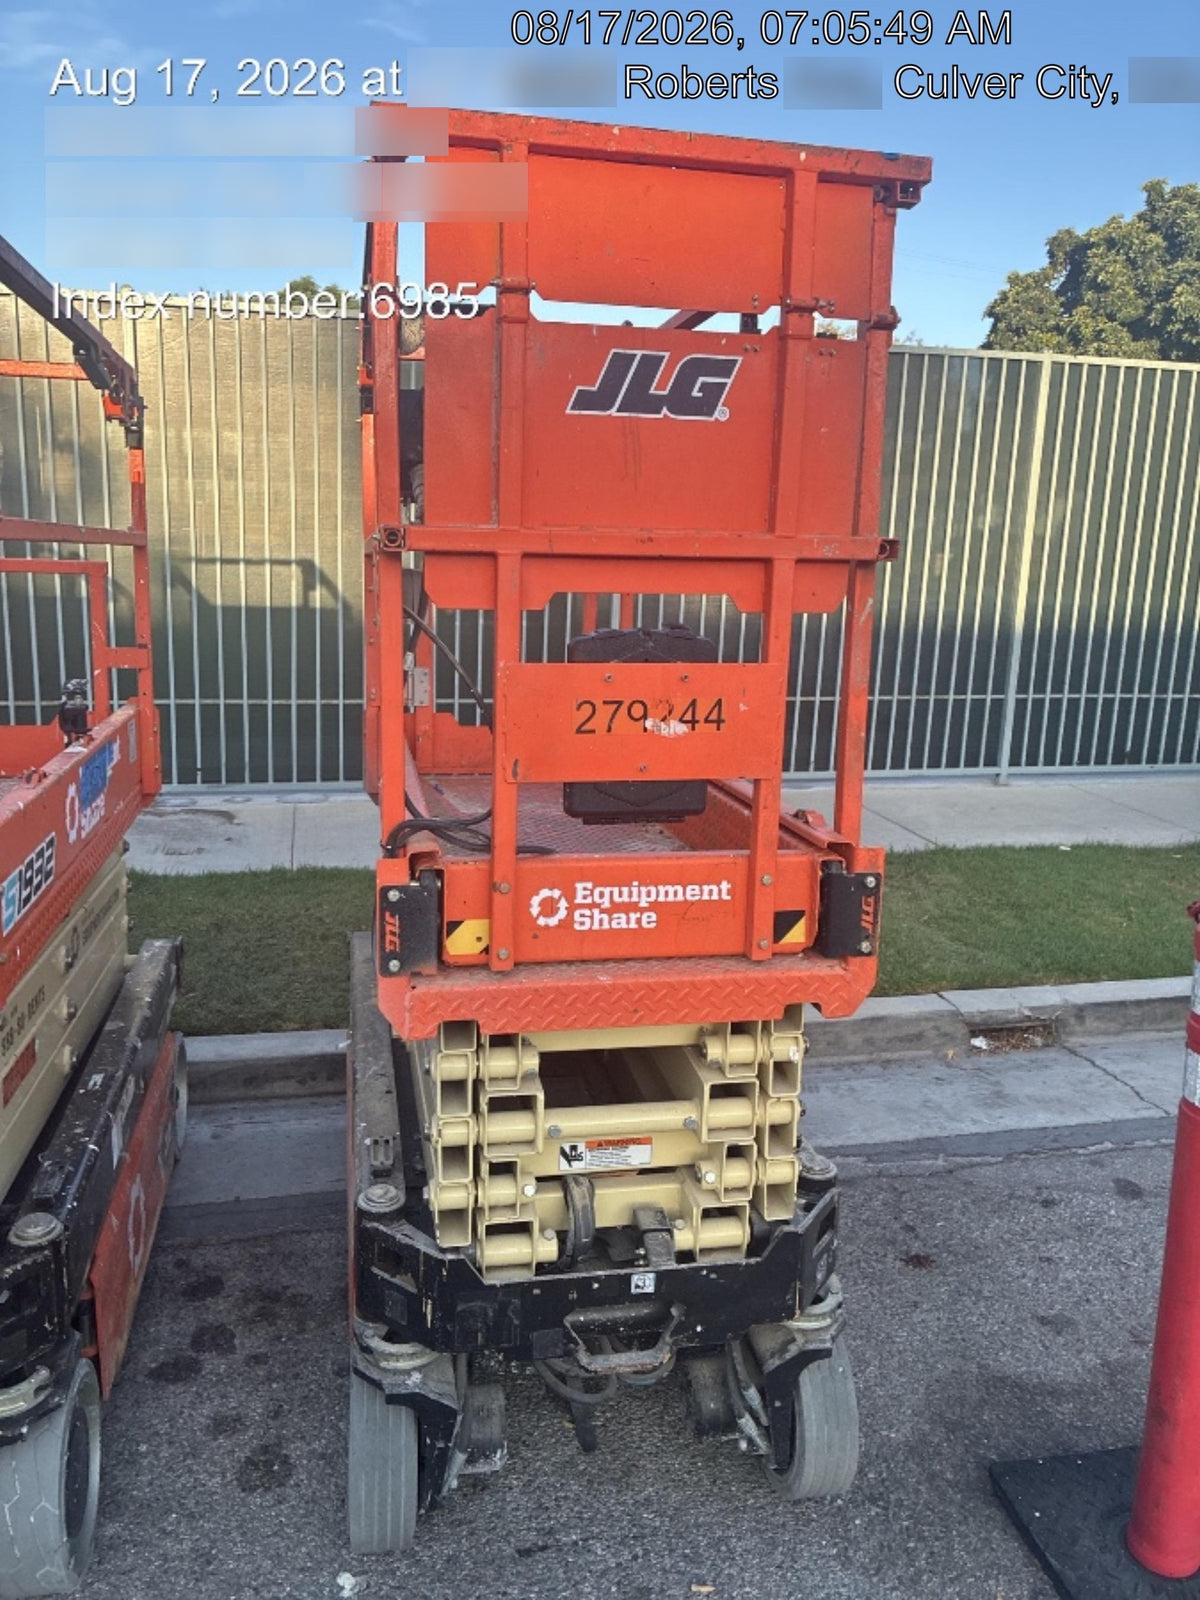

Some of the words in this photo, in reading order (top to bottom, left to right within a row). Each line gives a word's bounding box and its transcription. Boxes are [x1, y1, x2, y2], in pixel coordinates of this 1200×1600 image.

[574, 880, 731, 908] Equipment
[385, 910, 400, 953] JLG
[573, 907, 657, 931] Share
[861, 895, 876, 936] JLG
